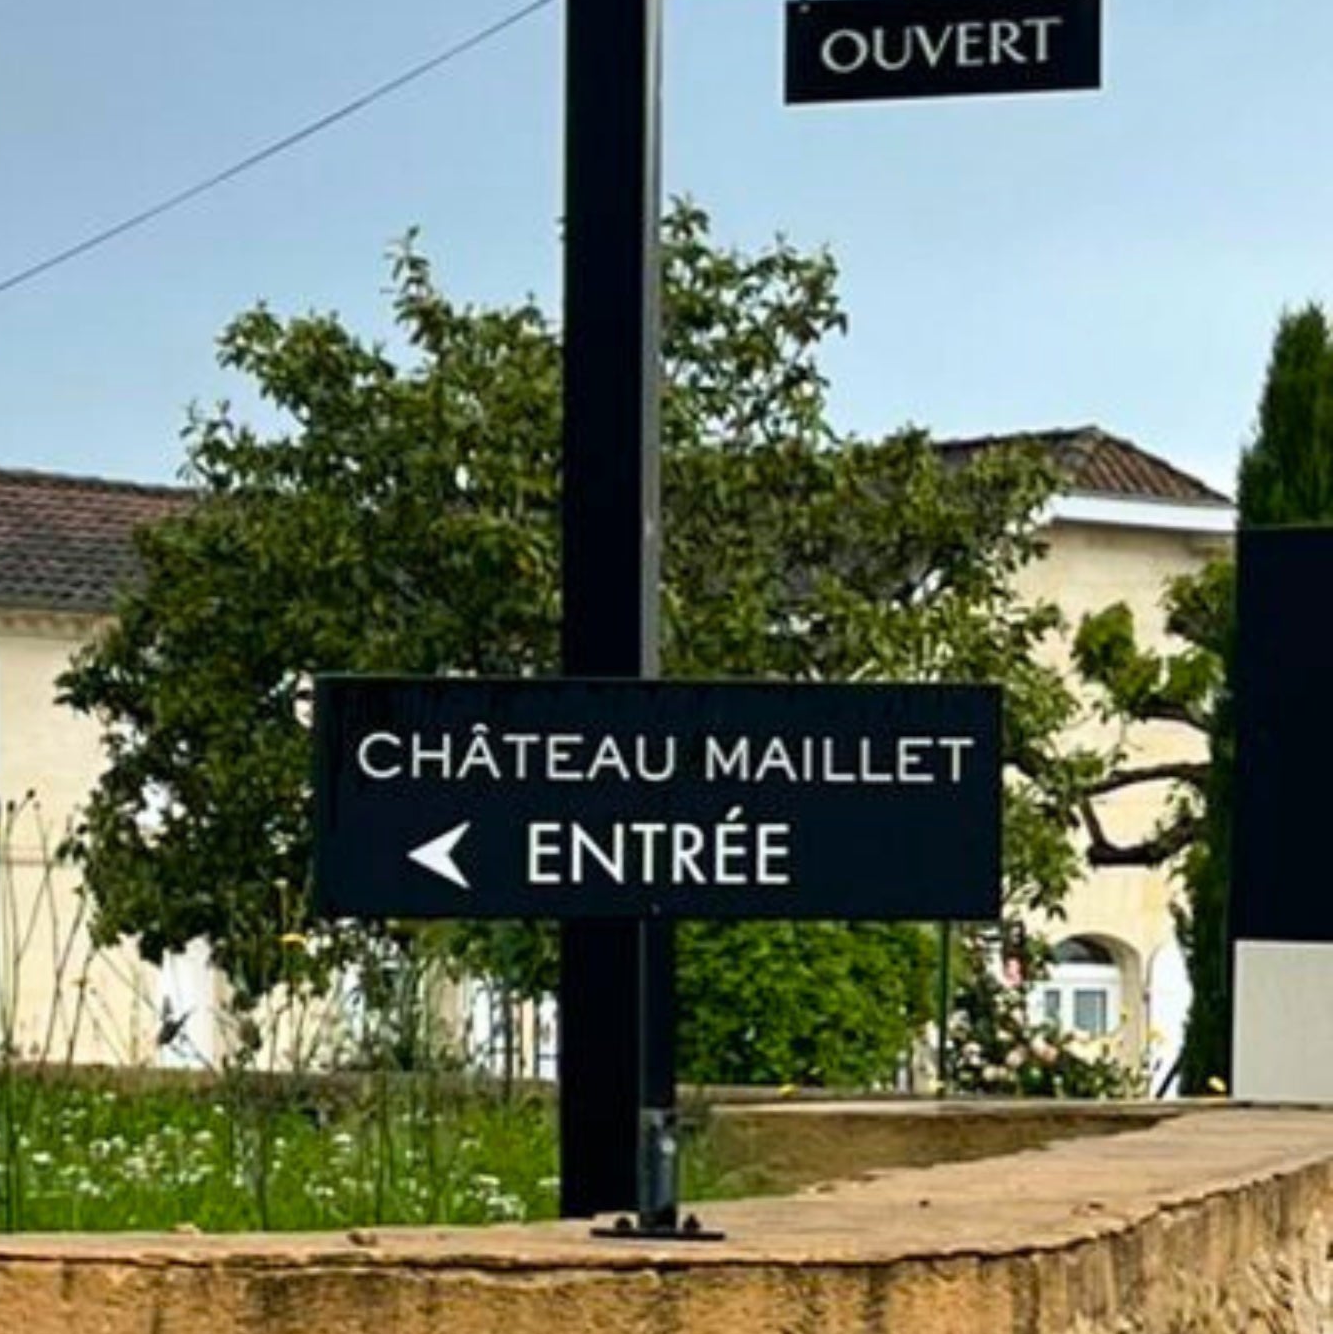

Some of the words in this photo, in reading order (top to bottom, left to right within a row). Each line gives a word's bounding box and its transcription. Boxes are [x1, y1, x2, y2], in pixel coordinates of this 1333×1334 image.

[821, 18, 1062, 73] OUVERT
[358, 723, 675, 782] CHÂTEAU
[705, 736, 974, 783] MAILLET
[528, 806, 790, 885] ENTRÉE
